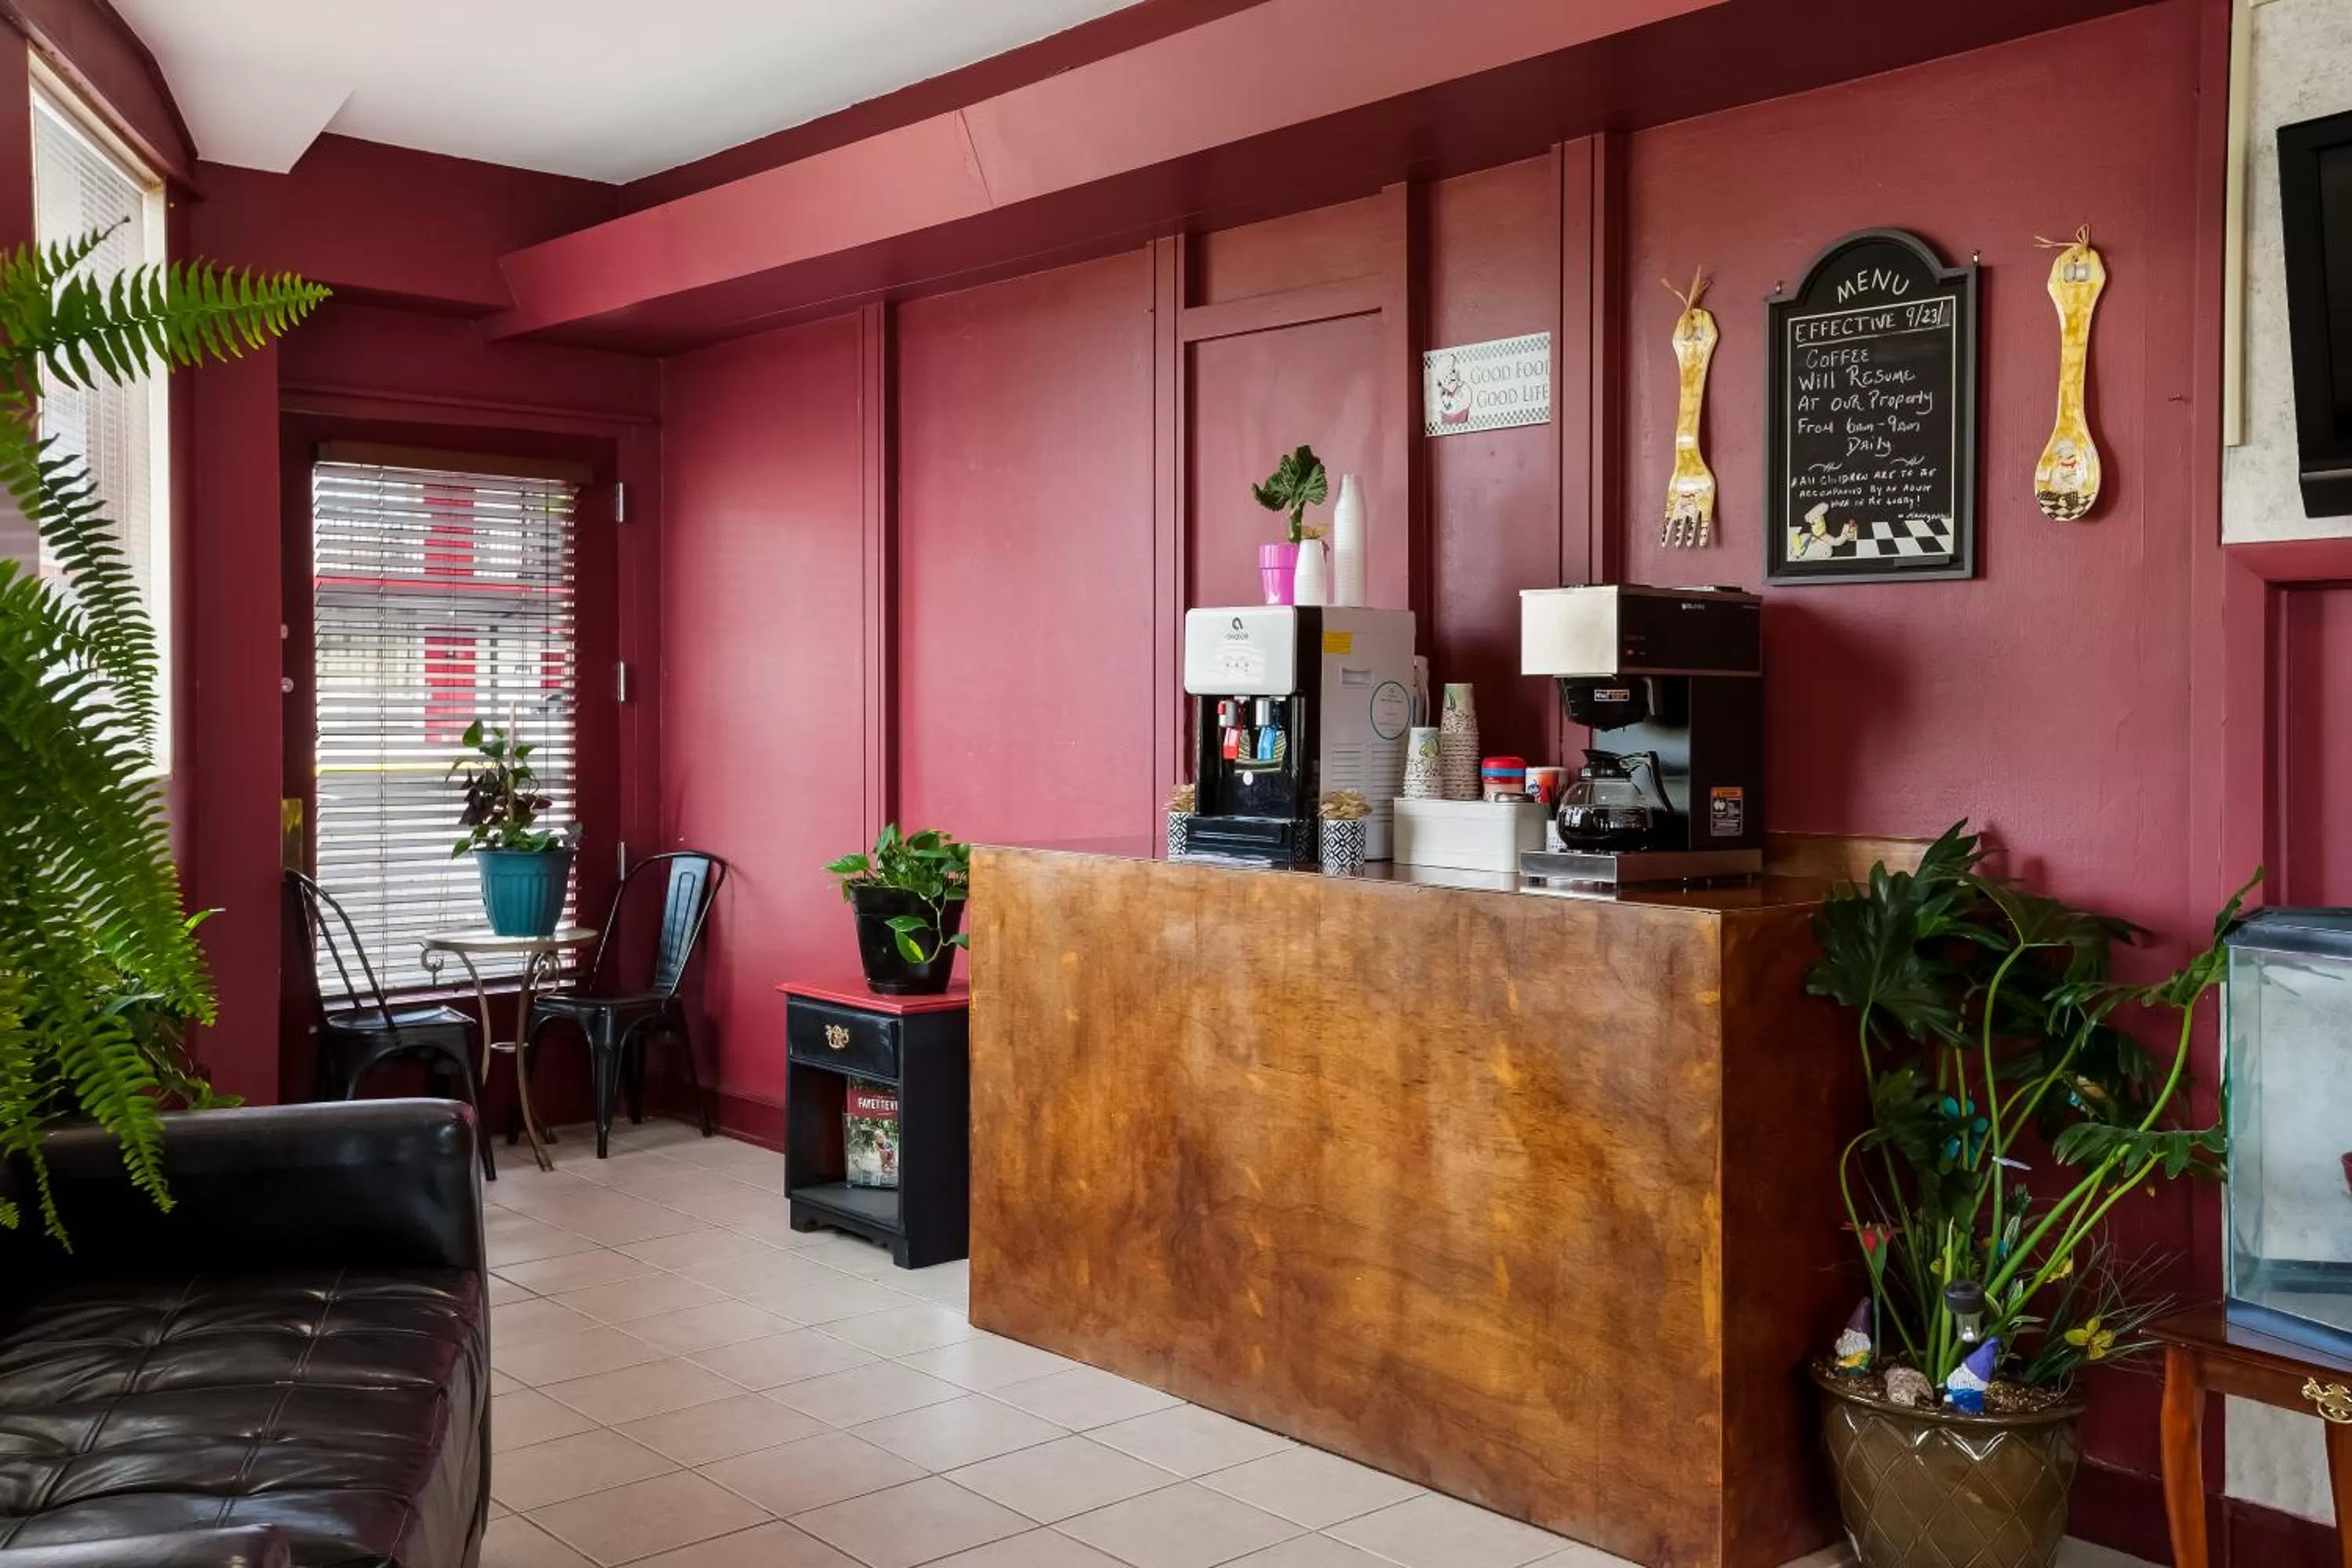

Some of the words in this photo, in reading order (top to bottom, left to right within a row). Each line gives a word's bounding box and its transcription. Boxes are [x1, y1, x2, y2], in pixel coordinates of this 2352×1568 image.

[1837, 267, 1910, 304] MENU
[1795, 314, 1896, 343] EFFECTIVE
[1470, 365, 1511, 385] GOOD
[1798, 370, 1835, 391] Will
[1476, 388, 1518, 408] GOOD
